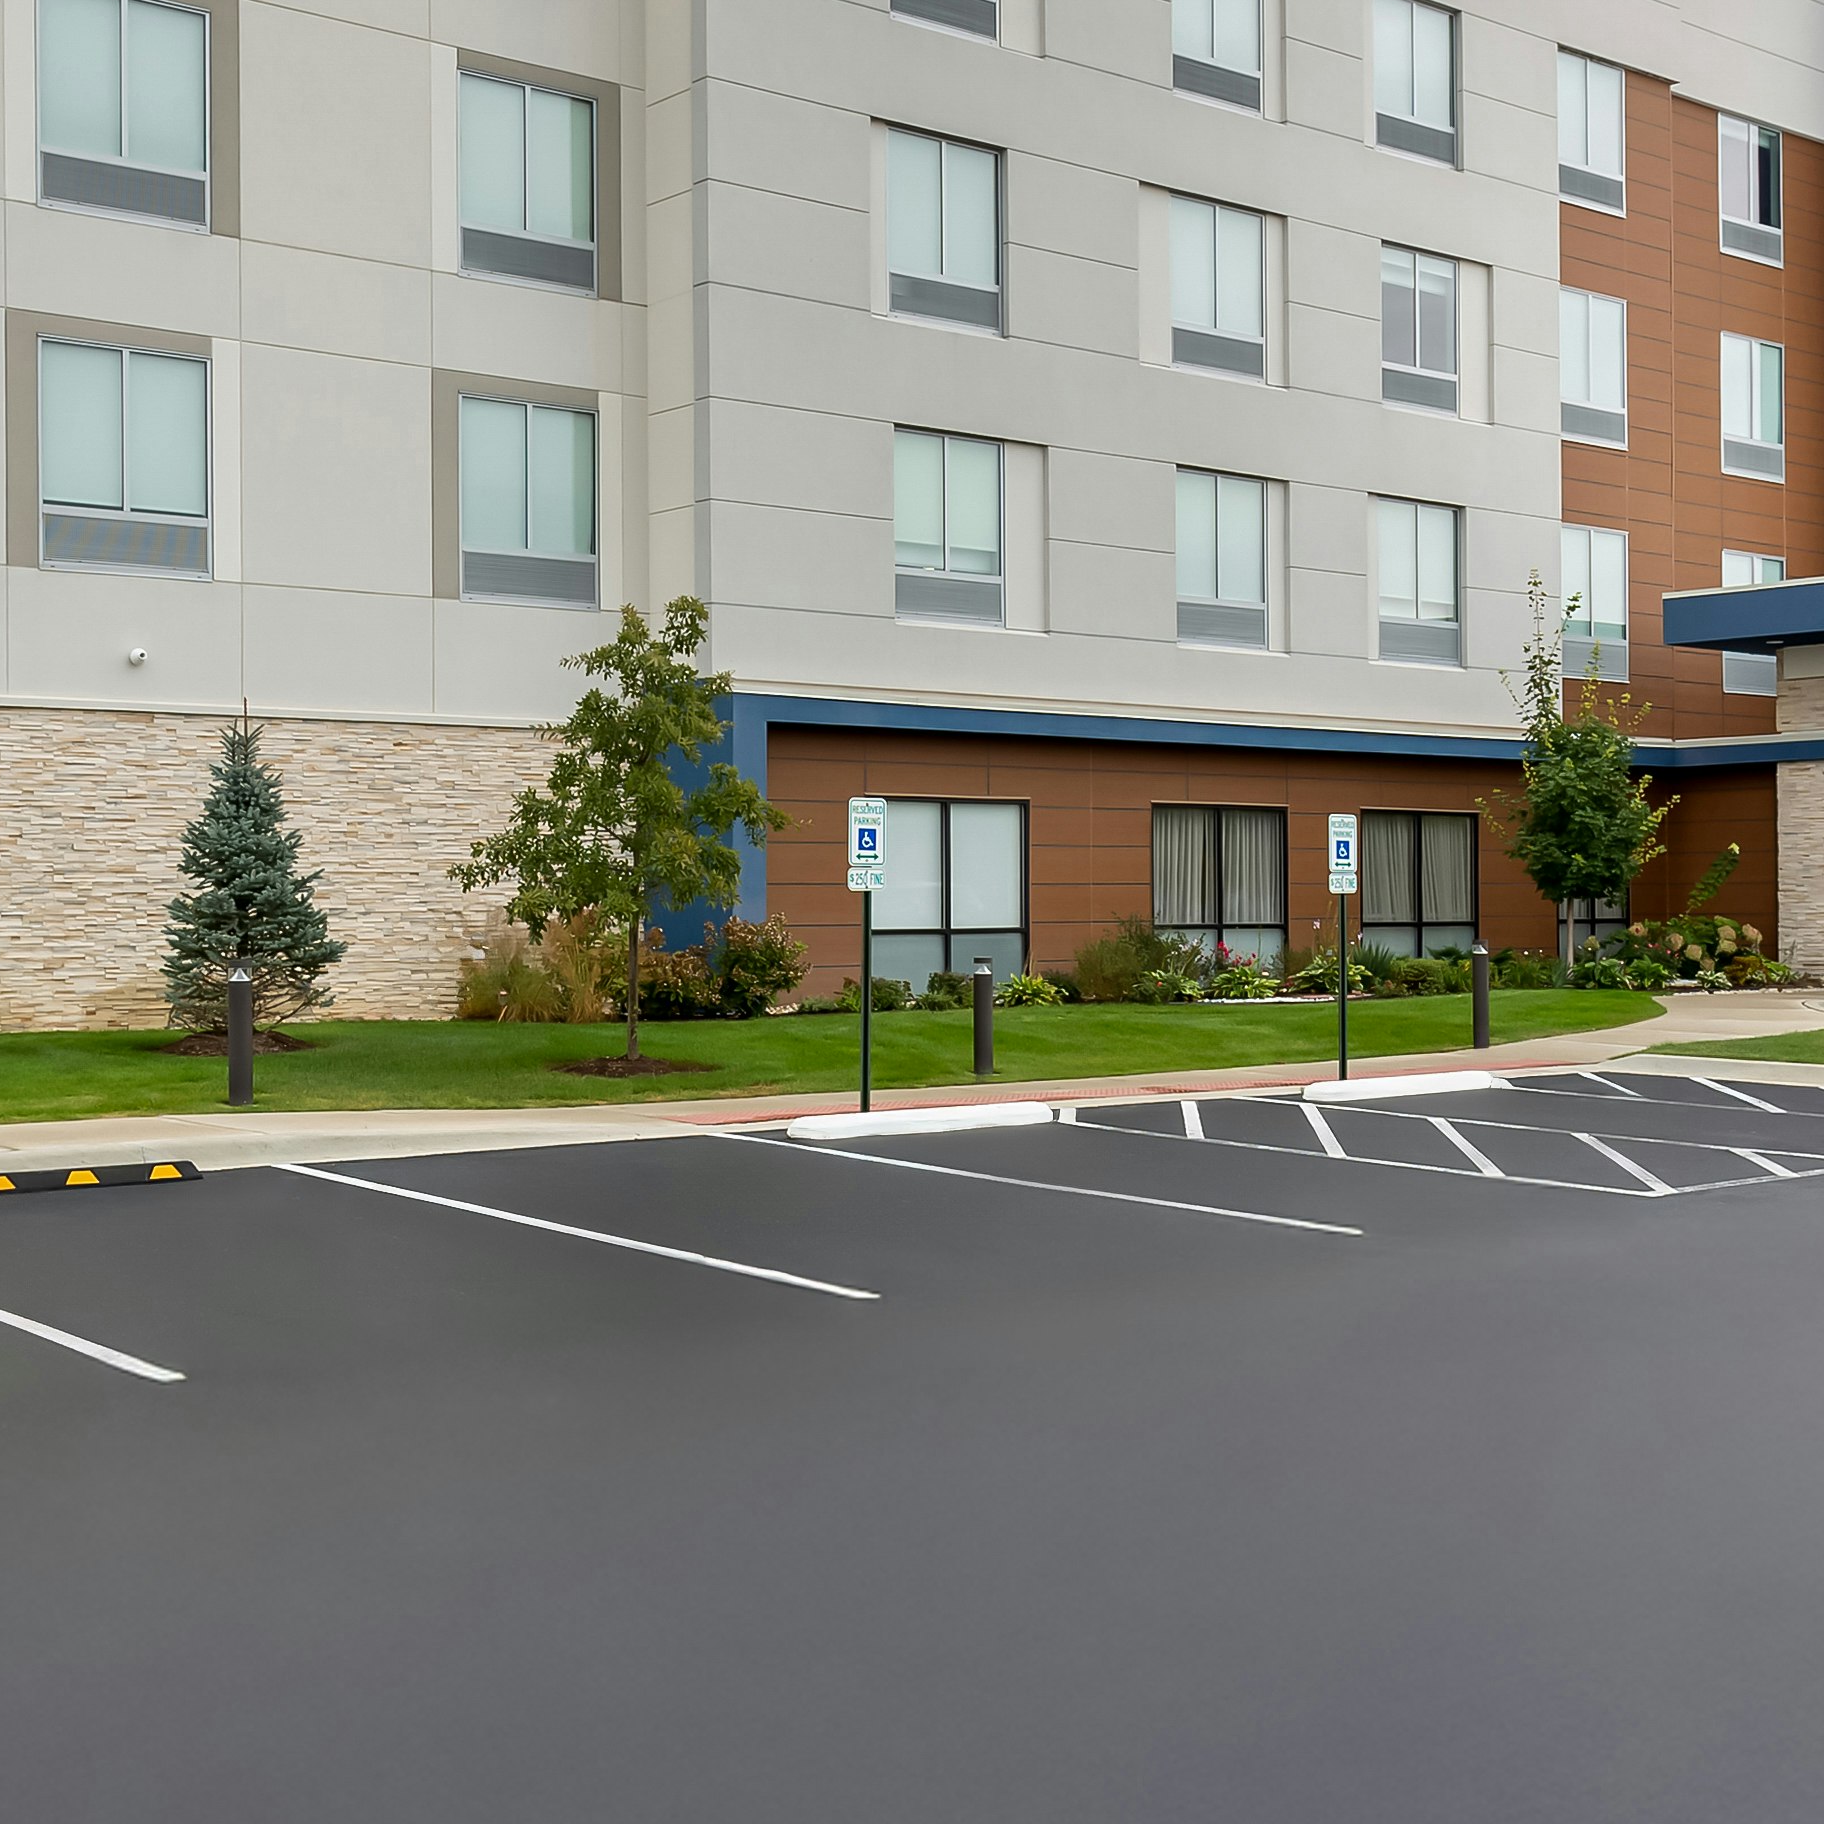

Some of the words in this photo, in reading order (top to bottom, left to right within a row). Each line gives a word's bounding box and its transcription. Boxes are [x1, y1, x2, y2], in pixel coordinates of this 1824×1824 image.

[852, 805, 883, 814] RESERVED
[853, 817, 881, 825] PARKING
[870, 873, 884, 885] FINE
